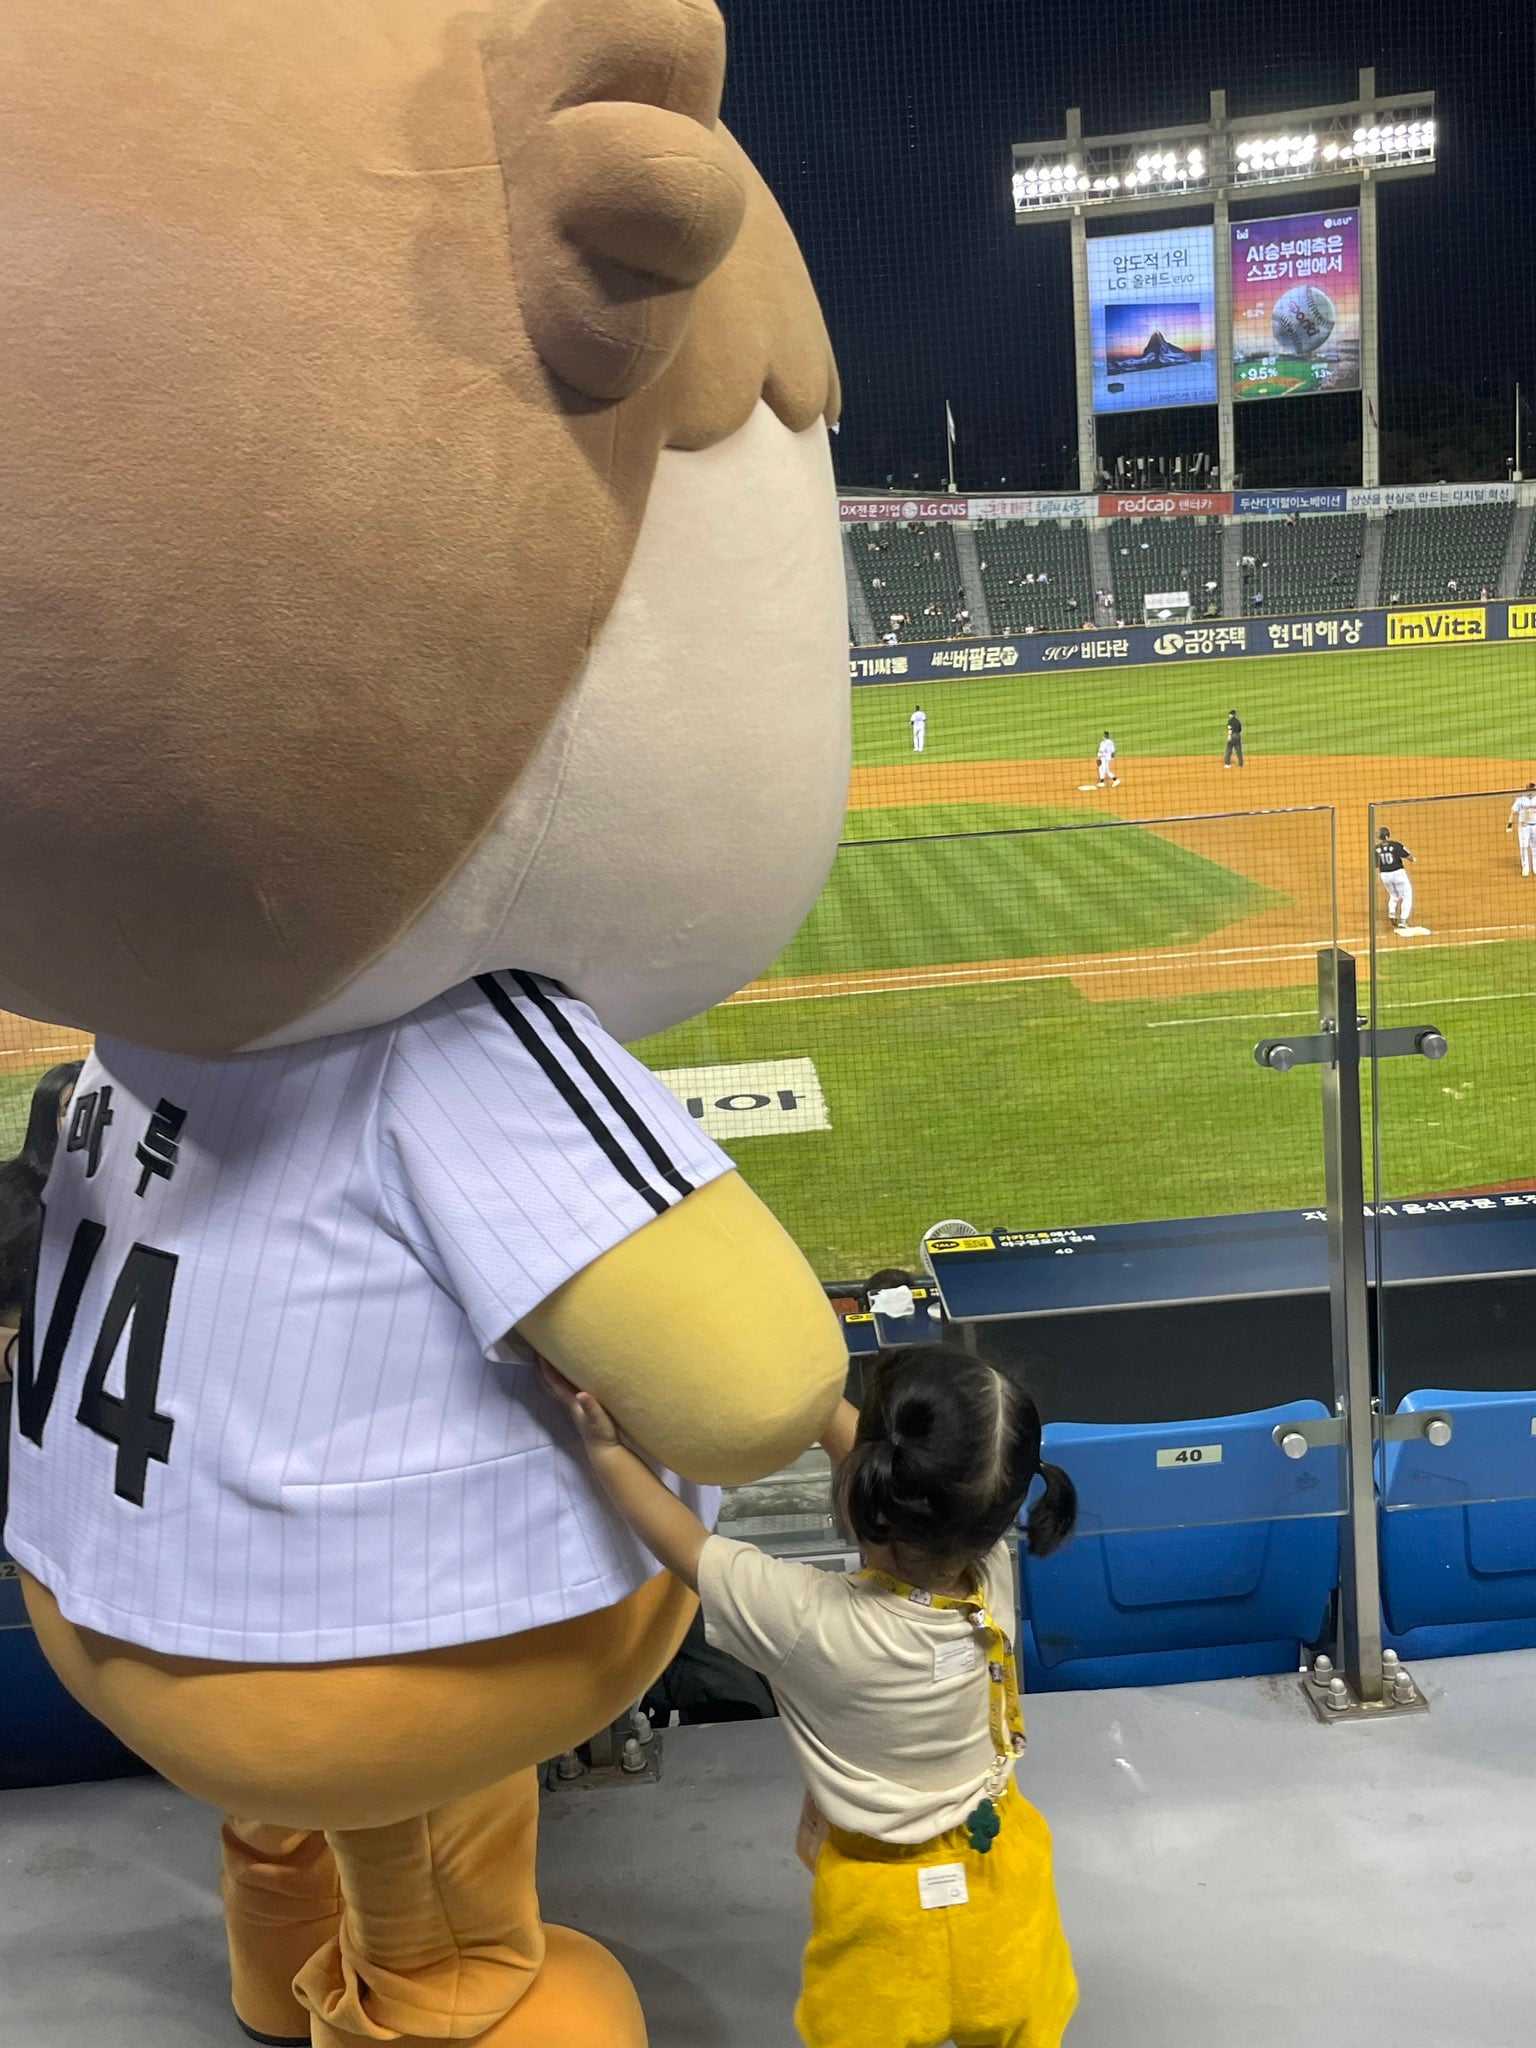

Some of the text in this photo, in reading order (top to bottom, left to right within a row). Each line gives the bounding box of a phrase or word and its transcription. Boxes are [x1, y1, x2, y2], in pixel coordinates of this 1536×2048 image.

[1246, 235, 1344, 263] AI승부예측은
[1113, 249, 1188, 274] 압도적 1위
[1246, 255, 1342, 282] 스포키 앱에서
[1108, 272, 1194, 290] LG 올레드 evo
[1117, 496, 1176, 514] redcap
[1239, 495, 1341, 510] 두산디지털이노베이션
[1351, 493, 1381, 506] 상상을
[1385, 492, 1417, 505] 현실로
[1418, 490, 1450, 503] 만드는
[1453, 488, 1485, 502] 디지털
[840, 503, 967, 518] DX전문기업 LG CNS
[1266, 618, 1364, 649] 현대해상
[1390, 615, 1482, 641] ImVita
[1080, 639, 1130, 660] 비타란
[1183, 625, 1247, 655] 금강주택
[67, 1085, 188, 1198] 마루
[1402, 1198, 1498, 1215] 음식주문
[1054, 1247, 1074, 1255] 40
[1175, 1449, 1203, 1463] 40
